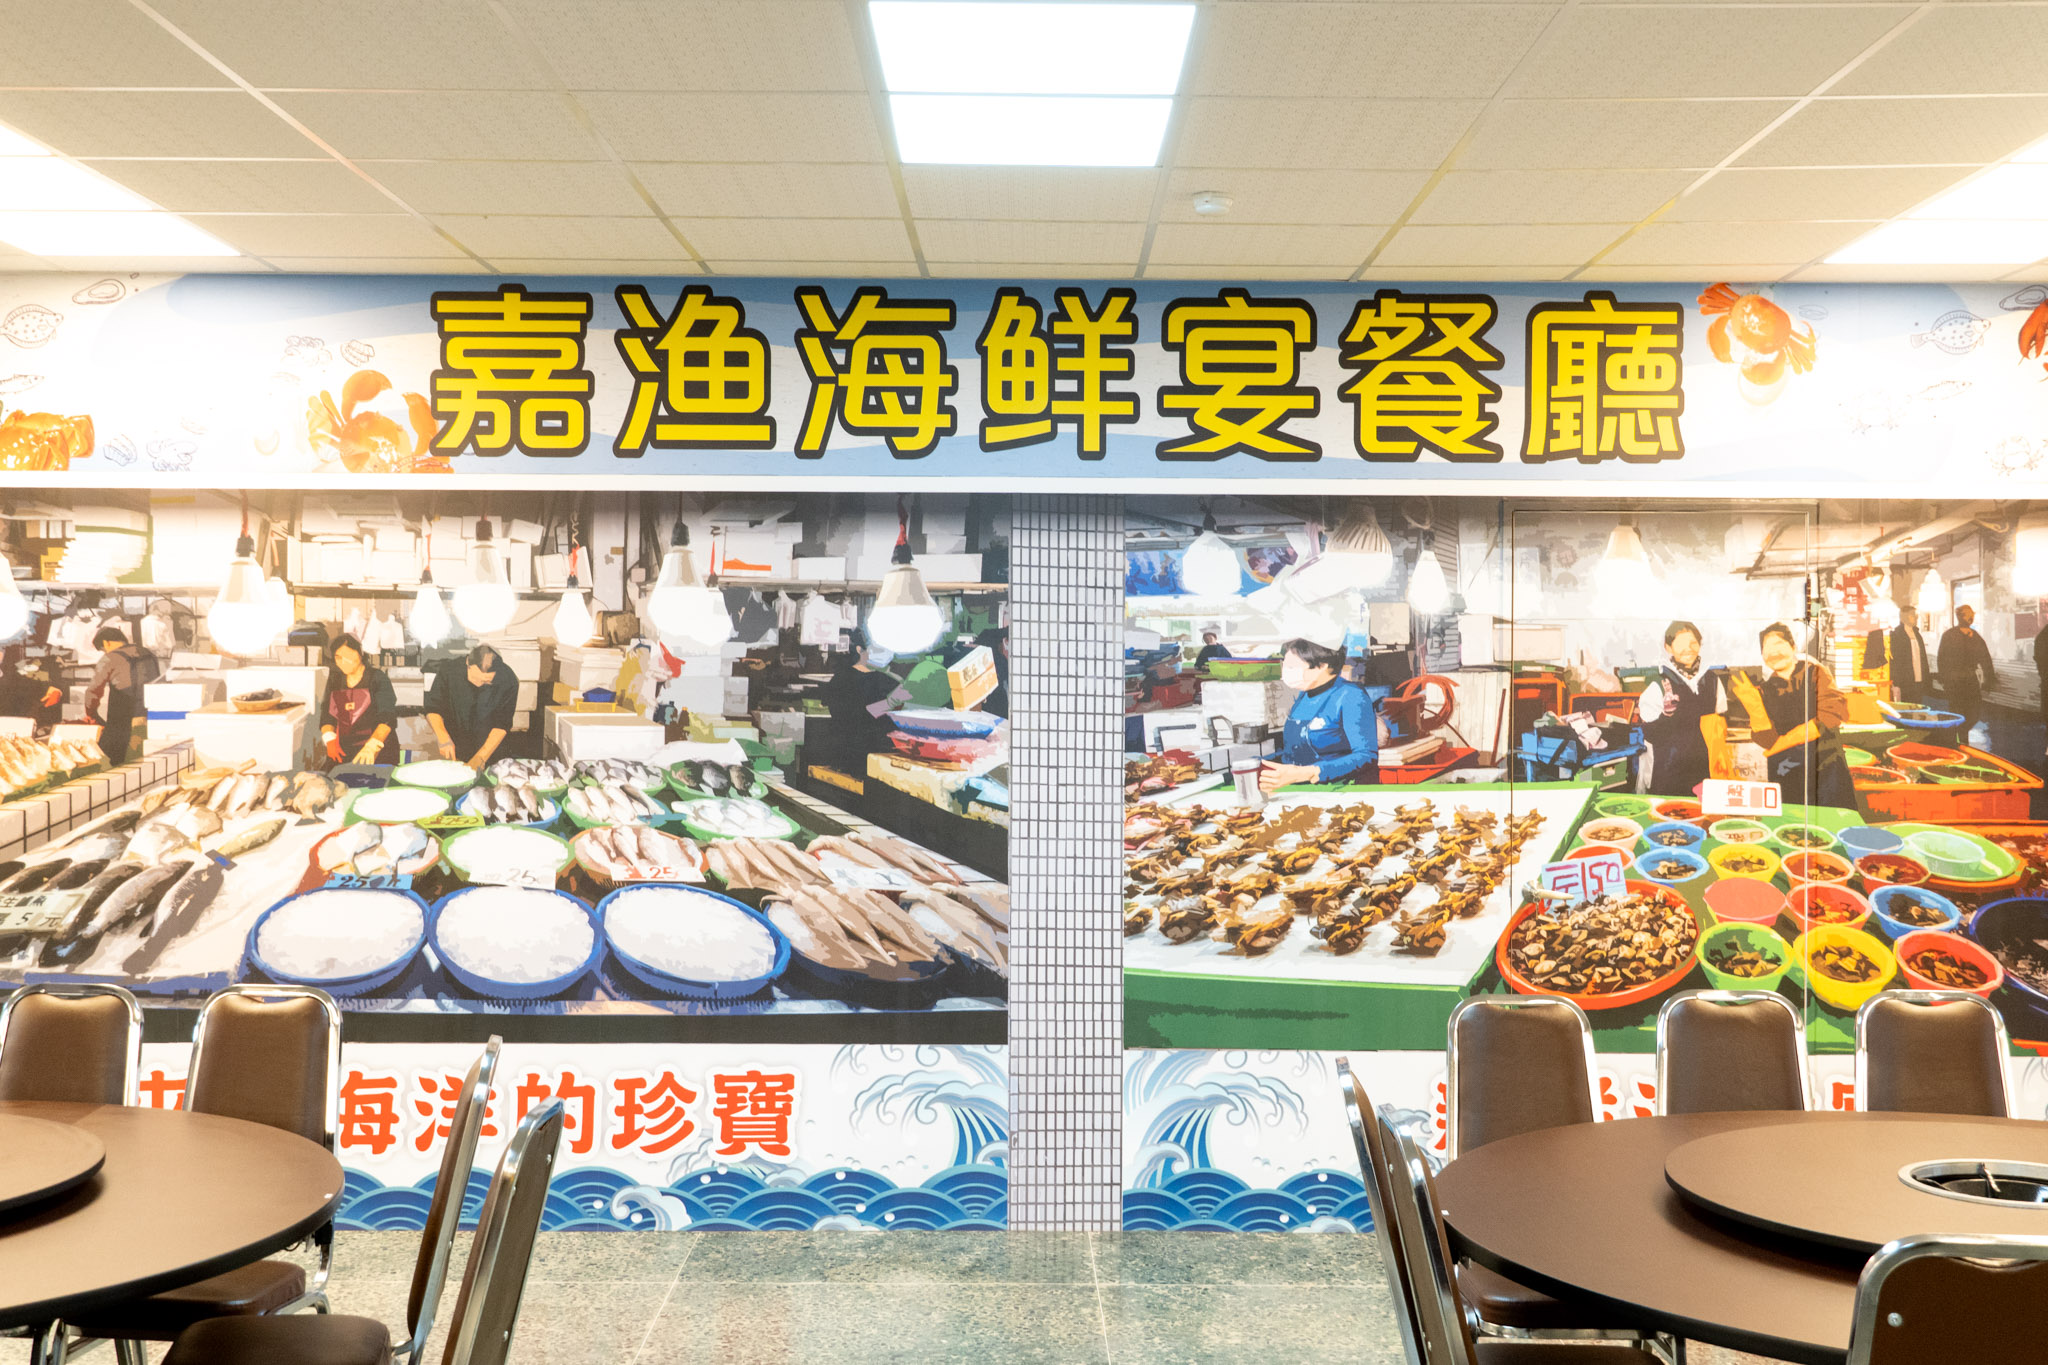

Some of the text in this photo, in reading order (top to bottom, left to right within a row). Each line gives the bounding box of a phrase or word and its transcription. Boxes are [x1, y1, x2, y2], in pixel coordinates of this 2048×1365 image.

[139, 1070, 796, 1156] 海洋的珍寶
